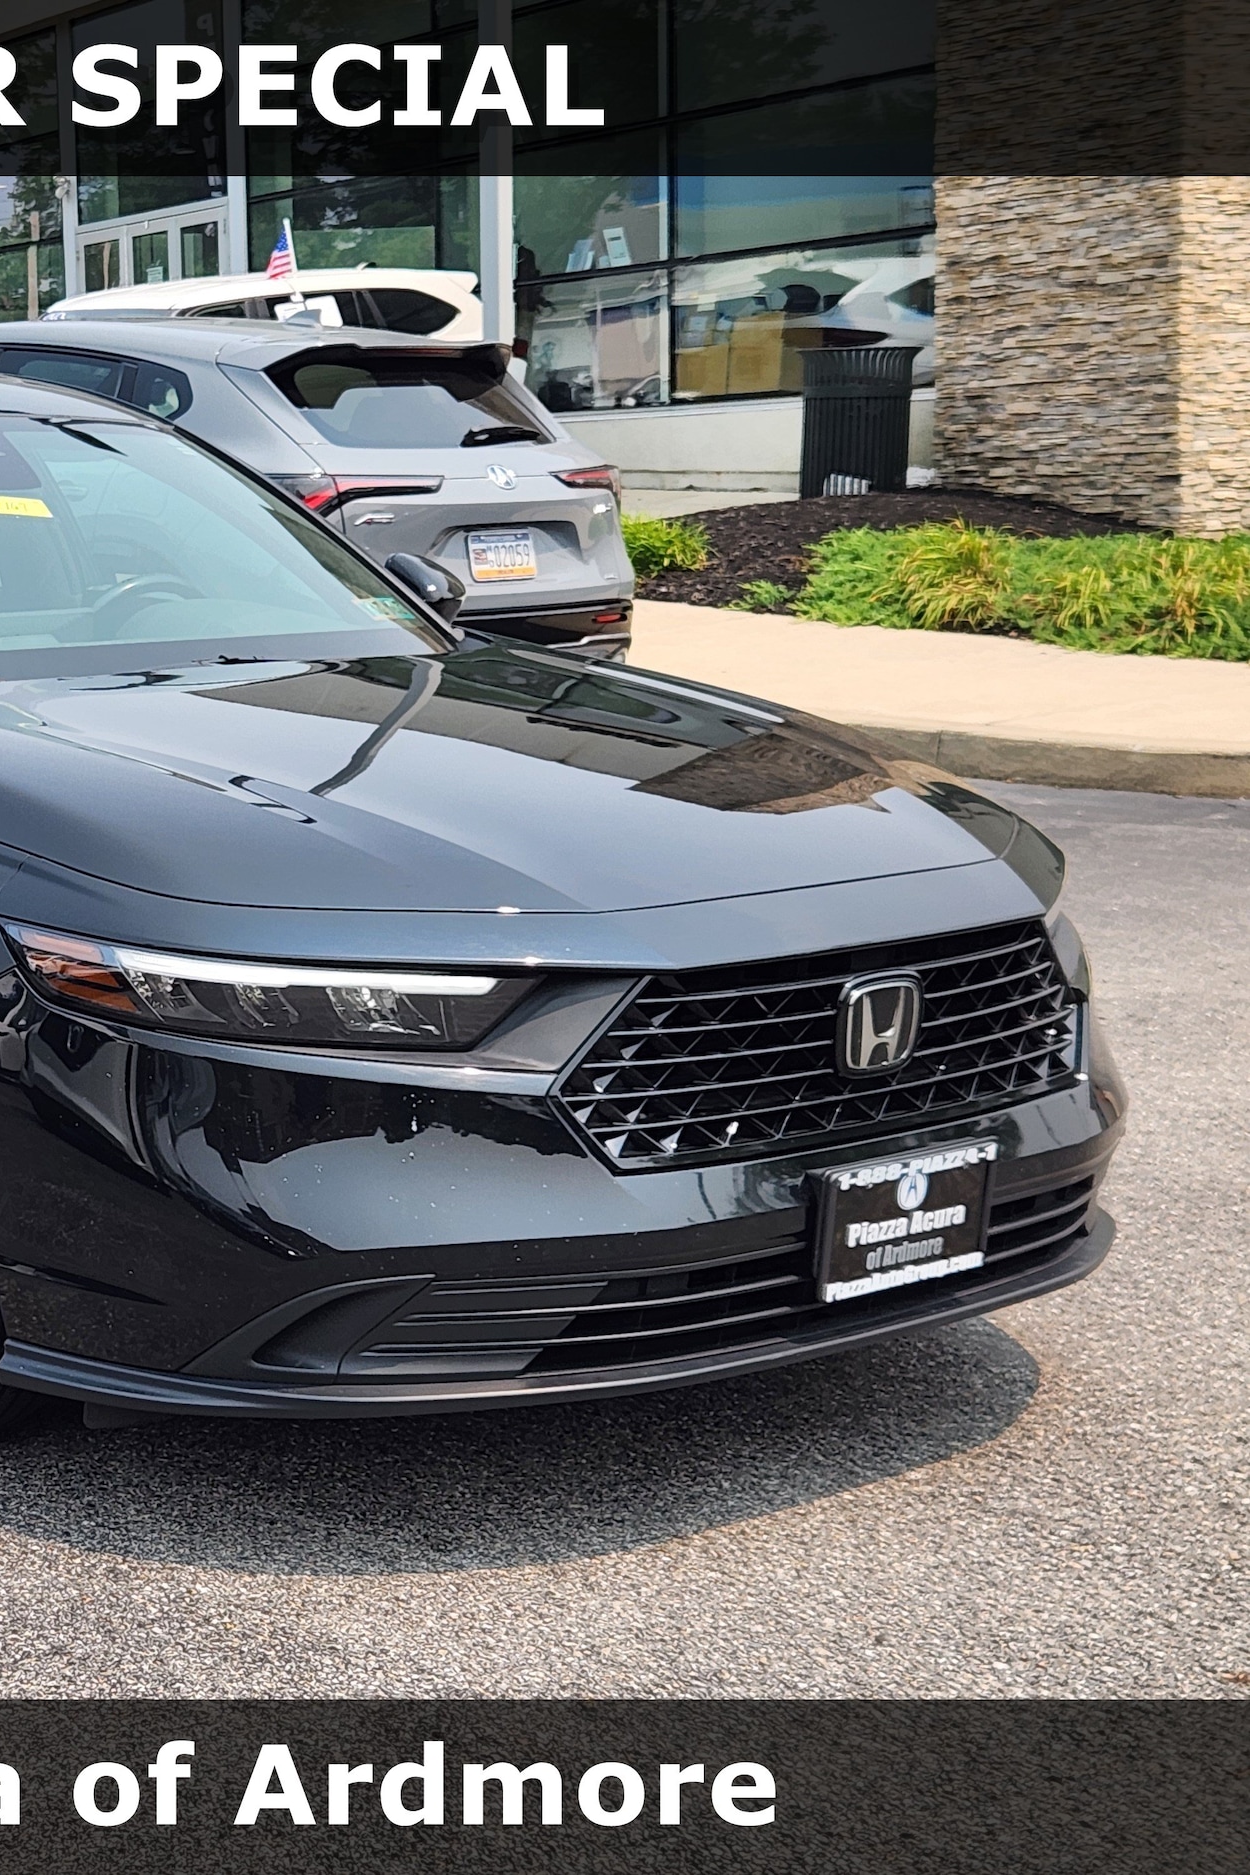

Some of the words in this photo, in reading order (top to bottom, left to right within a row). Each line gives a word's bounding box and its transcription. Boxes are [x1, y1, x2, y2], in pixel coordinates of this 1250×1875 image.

[493, 543, 530, 568] 02059
[846, 1216, 909, 1248] Piazza
[909, 1204, 967, 1235] Acura
[865, 1246, 883, 1270] of
[882, 1236, 945, 1268] Ardmore
